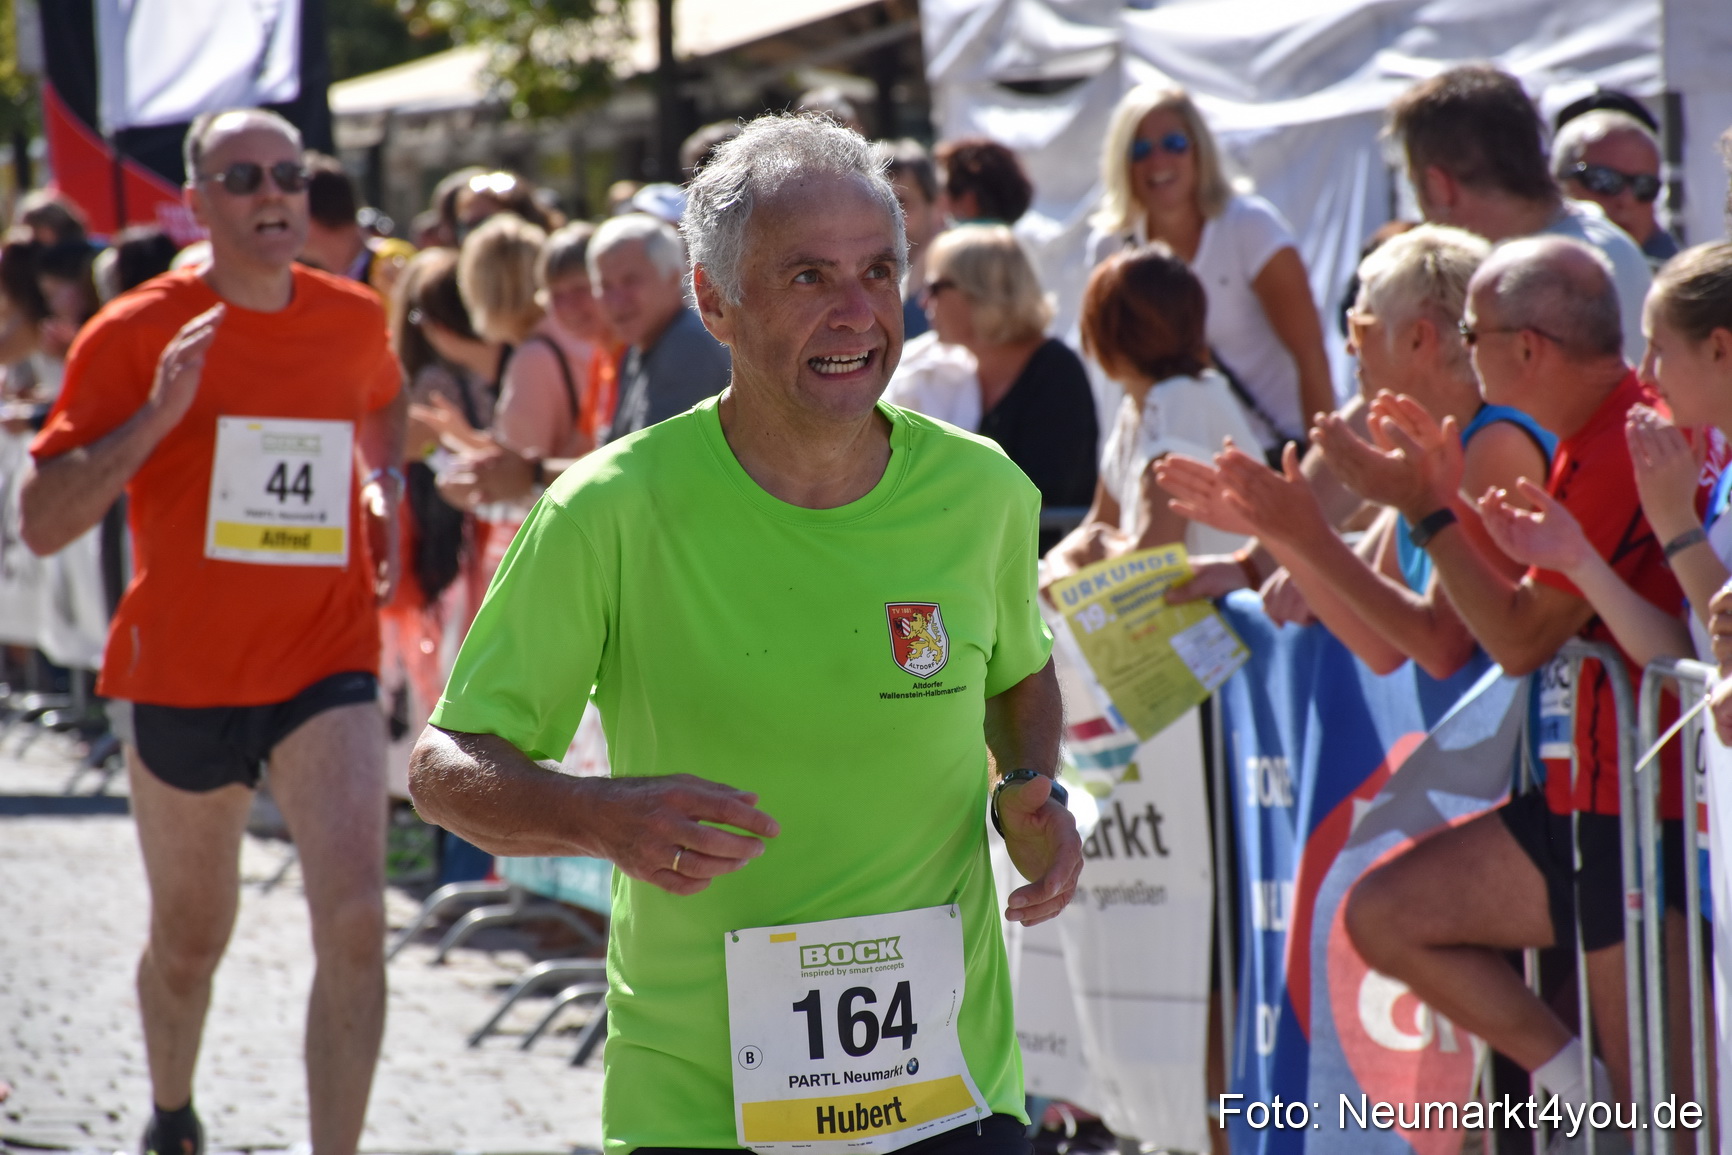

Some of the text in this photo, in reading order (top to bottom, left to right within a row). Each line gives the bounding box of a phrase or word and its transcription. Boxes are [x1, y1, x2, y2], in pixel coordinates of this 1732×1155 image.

[265, 462, 313, 504] 44
[260, 531, 311, 549] Alfred
[1061, 552, 1178, 606] URKUNDE
[908, 662, 935, 670] ALTDORF
[880, 685, 967, 699] Wallenstein-Halbmarathon
[912, 681, 943, 690] Altdorfer
[800, 936, 903, 969] BOCK
[801, 962, 904, 978] inspired by smart concepts
[792, 980, 918, 1060] 164
[745, 1052, 755, 1065] B
[789, 1065, 903, 1088] PARTL Neumarkt
[816, 1096, 907, 1134] Hubert
